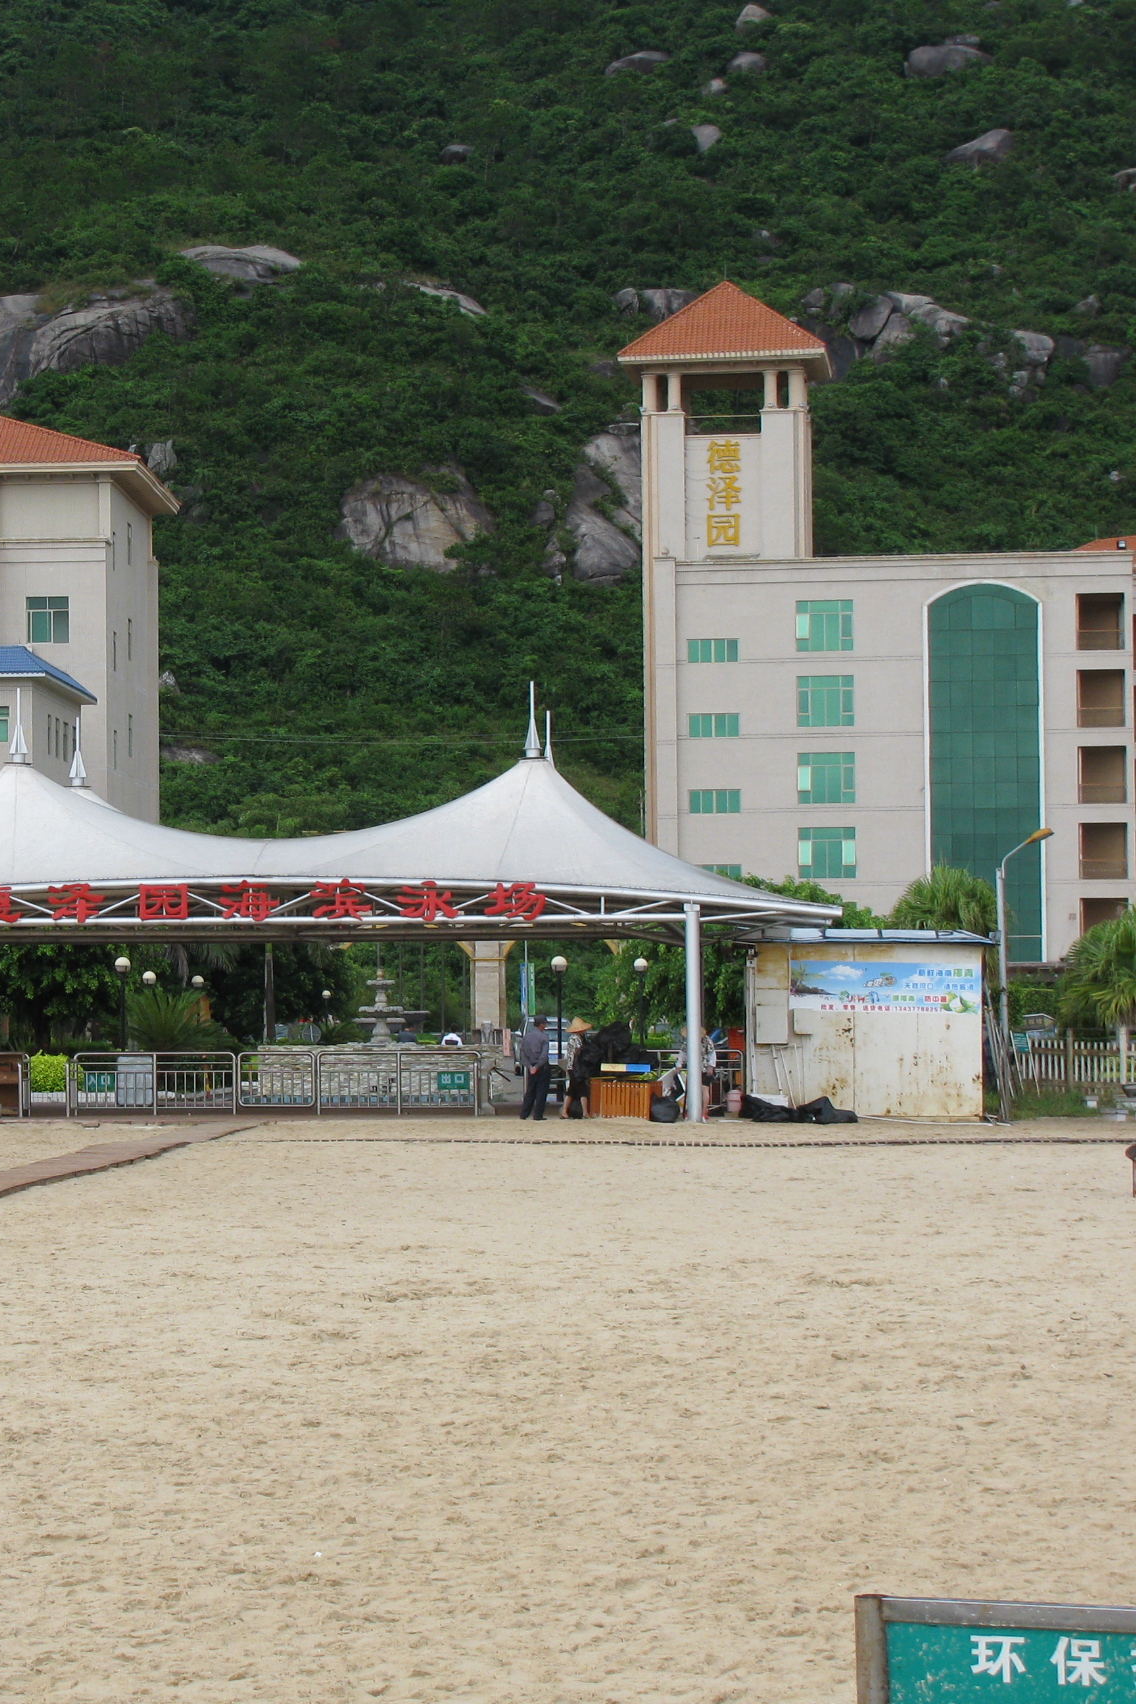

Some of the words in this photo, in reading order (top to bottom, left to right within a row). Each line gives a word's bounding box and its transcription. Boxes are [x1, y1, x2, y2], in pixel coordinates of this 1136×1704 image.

[706, 439, 741, 547] 德泽园
[88, 1075, 111, 1086] 入口
[441, 1073, 465, 1084] 出口
[970, 1634, 1136, 1687] 环保
